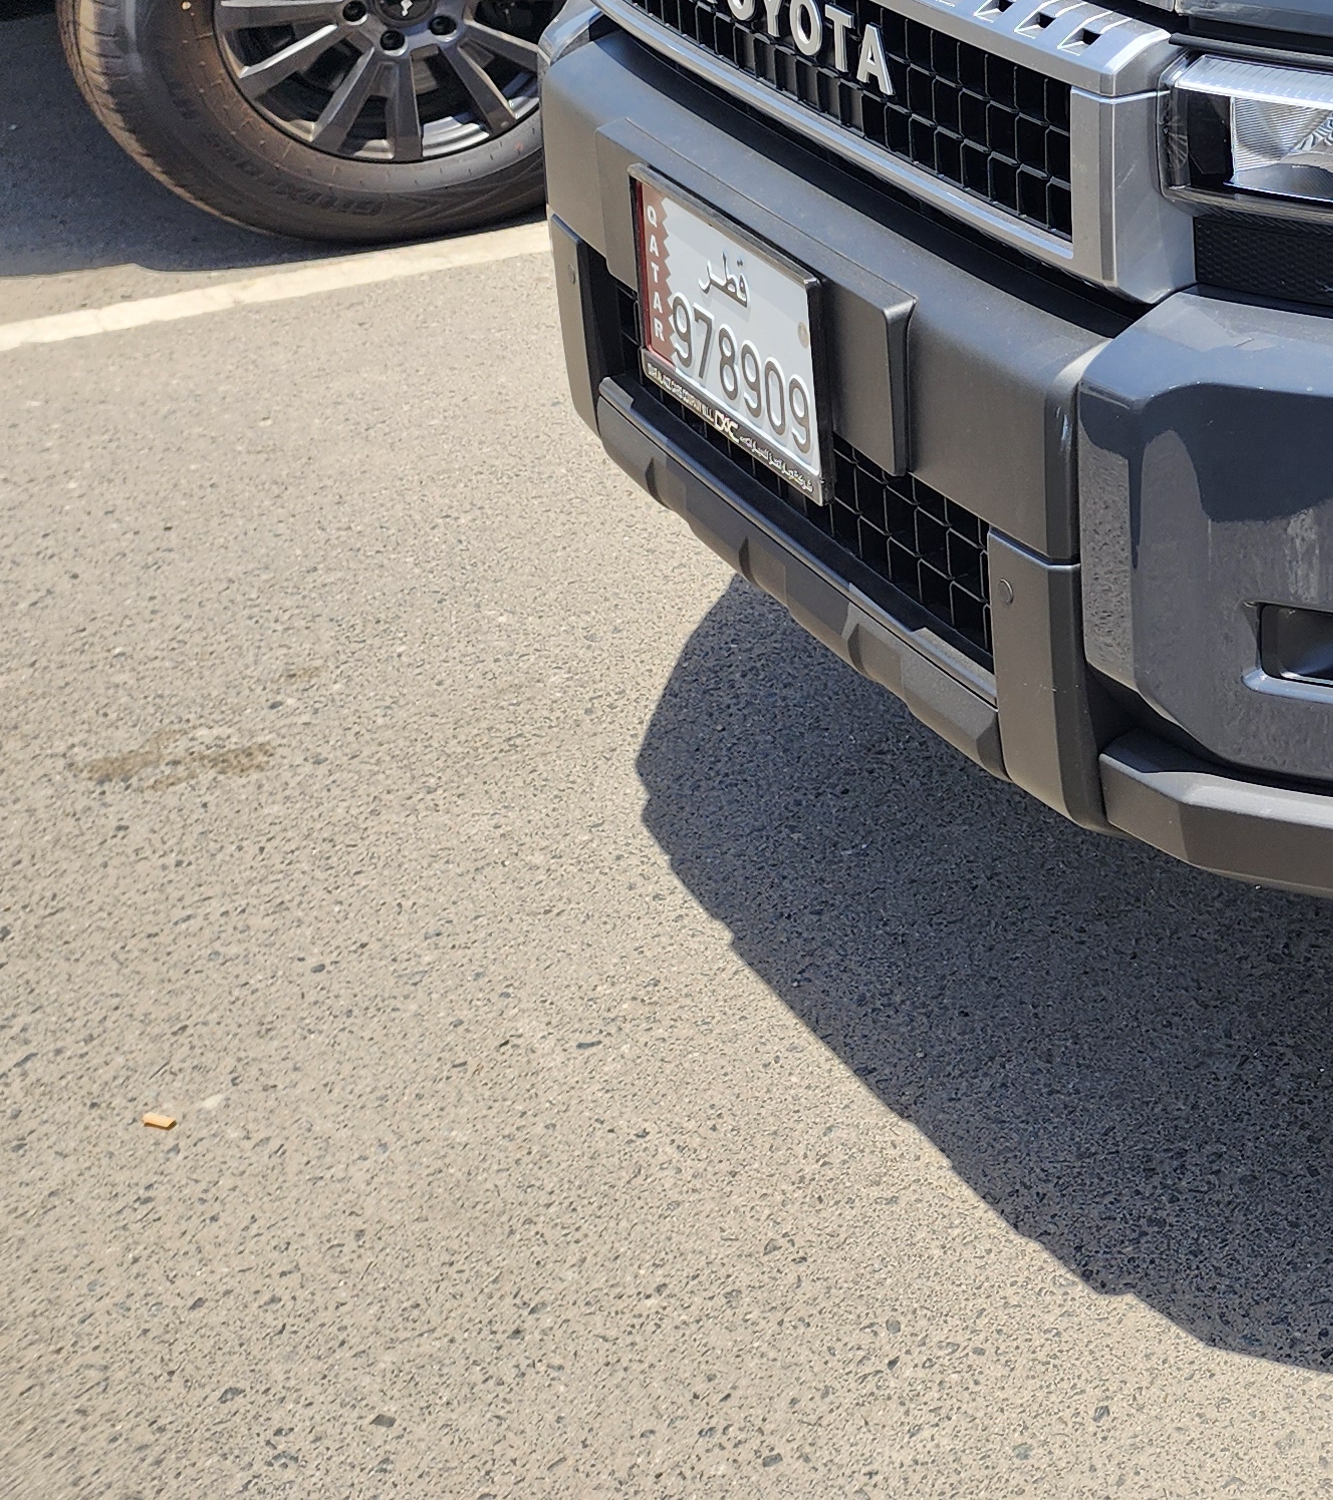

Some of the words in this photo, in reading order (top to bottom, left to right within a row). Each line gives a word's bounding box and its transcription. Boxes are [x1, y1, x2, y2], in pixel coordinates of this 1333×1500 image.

[647, 205, 665, 342] QATAR
[698, 251, 751, 309] قطر
[672, 291, 812, 455] 978909
